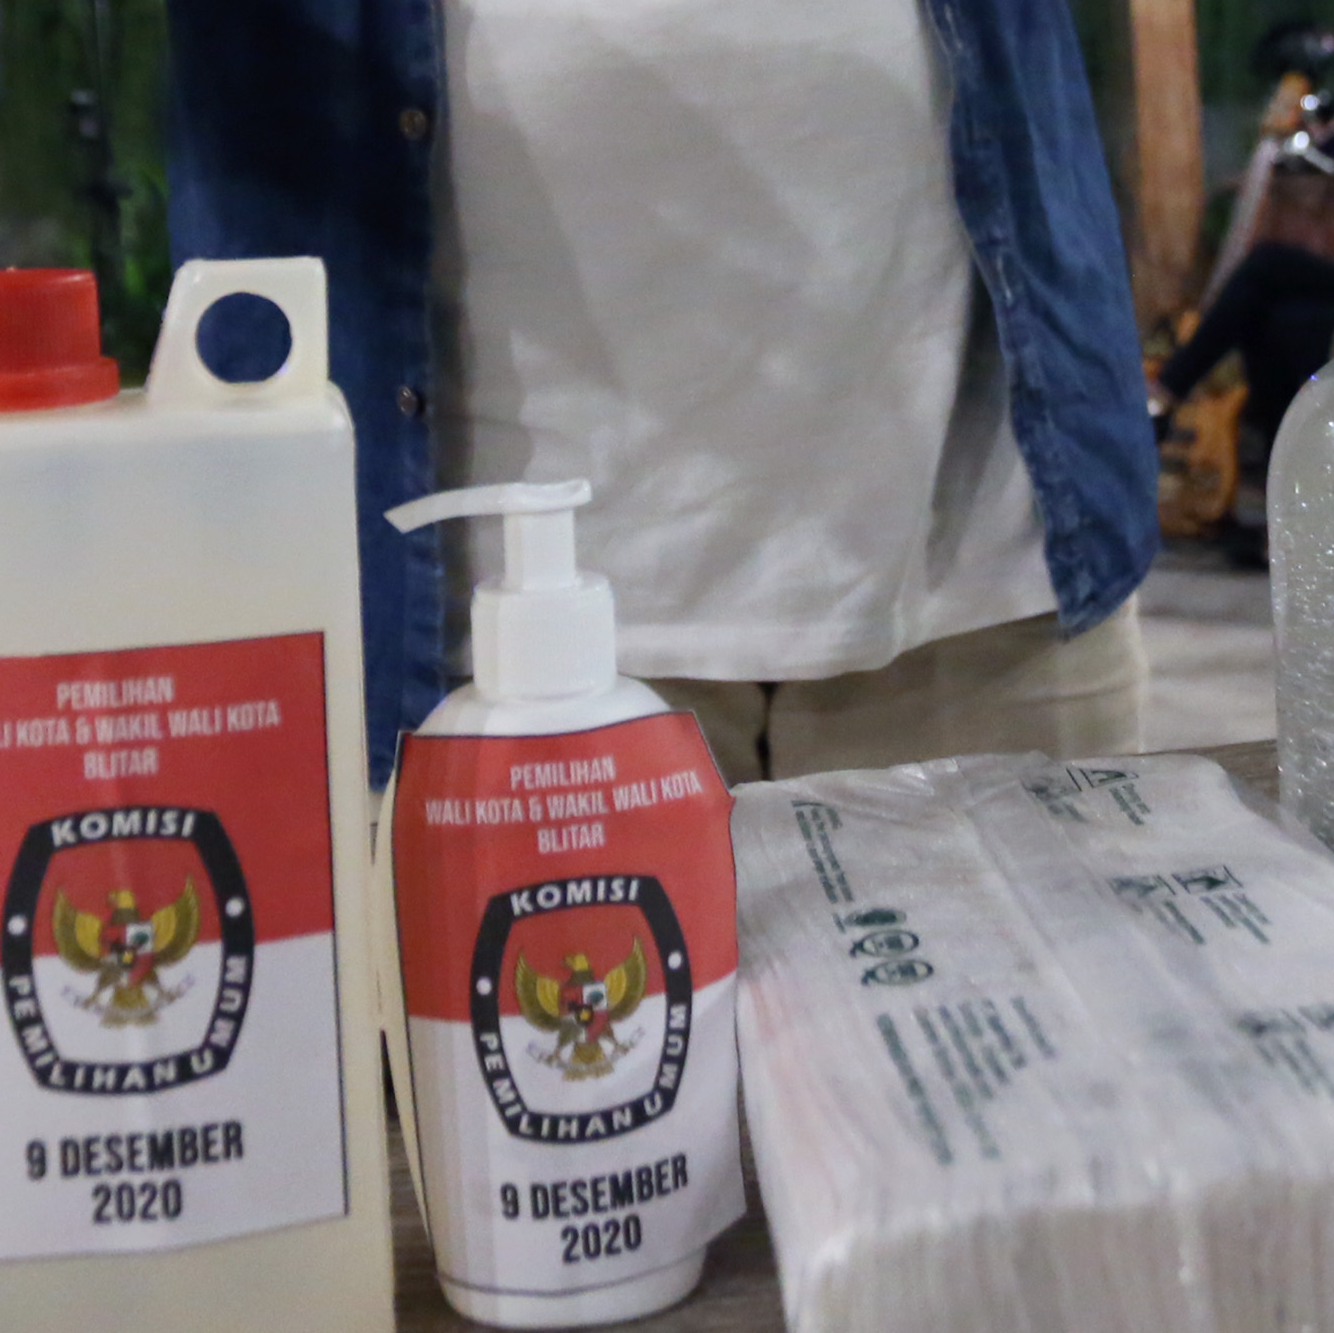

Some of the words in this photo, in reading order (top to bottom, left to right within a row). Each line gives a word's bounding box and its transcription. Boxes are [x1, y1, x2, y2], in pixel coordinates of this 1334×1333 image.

[57, 676, 175, 710] PEMILIHAN
[15, 719, 69, 747] KOTA
[76, 719, 90, 745] &
[94, 713, 164, 745] WAKIL
[168, 706, 222, 737] WALI
[227, 700, 281, 732] KOTA
[83, 748, 159, 779] BLITAR
[510, 754, 617, 791] PEMILIHAN
[425, 800, 470, 826] WALI
[475, 799, 523, 824] KOTA
[529, 798, 542, 821] &
[546, 791, 609, 820] WAKIL
[613, 779, 658, 812] WALI
[661, 770, 703, 803] KOTA
[51, 811, 196, 848] KOMISI
[538, 823, 606, 854] BLITAR
[510, 877, 640, 917] KOMISI
[7, 975, 178, 1090] PEMILIHAN
[190, 954, 248, 1074] UMUM
[479, 1032, 633, 1139] PEMILIHAN
[643, 1004, 688, 1116] UMUM
[26, 1140, 46, 1180] 9
[60, 1120, 244, 1177] DESEMBER
[92, 1181, 184, 1224] 2020
[500, 1183, 519, 1219] 9
[530, 1153, 689, 1221] DESEMBER
[560, 1214, 642, 1265] 2020
